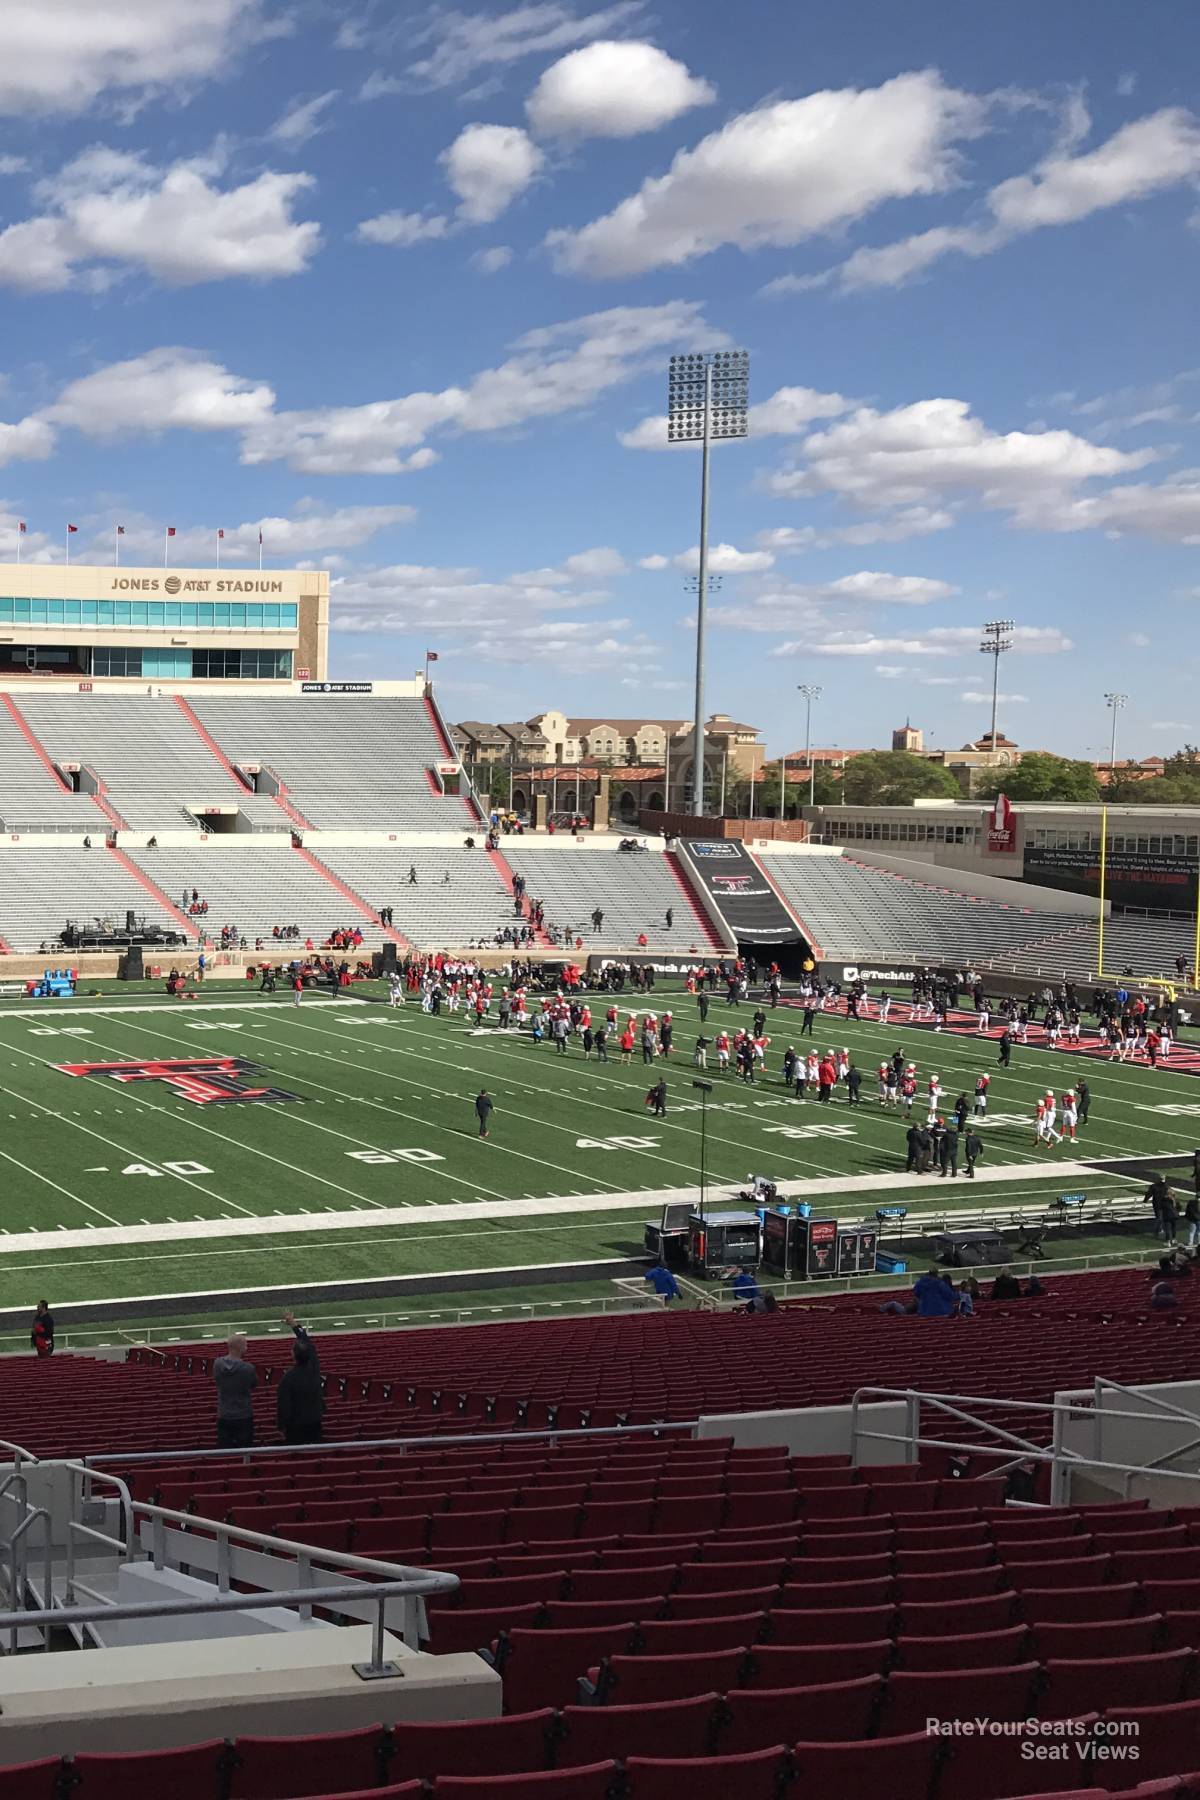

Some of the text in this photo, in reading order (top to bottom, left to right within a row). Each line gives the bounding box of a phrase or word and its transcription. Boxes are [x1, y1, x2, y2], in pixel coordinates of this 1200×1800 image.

[111, 578, 283, 593] JONES AT&T STADIUM
[653, 963, 678, 973] Tech
[575, 1136, 662, 1150] 40
[343, 1148, 447, 1164] 50
[121, 1161, 215, 1176] 40
